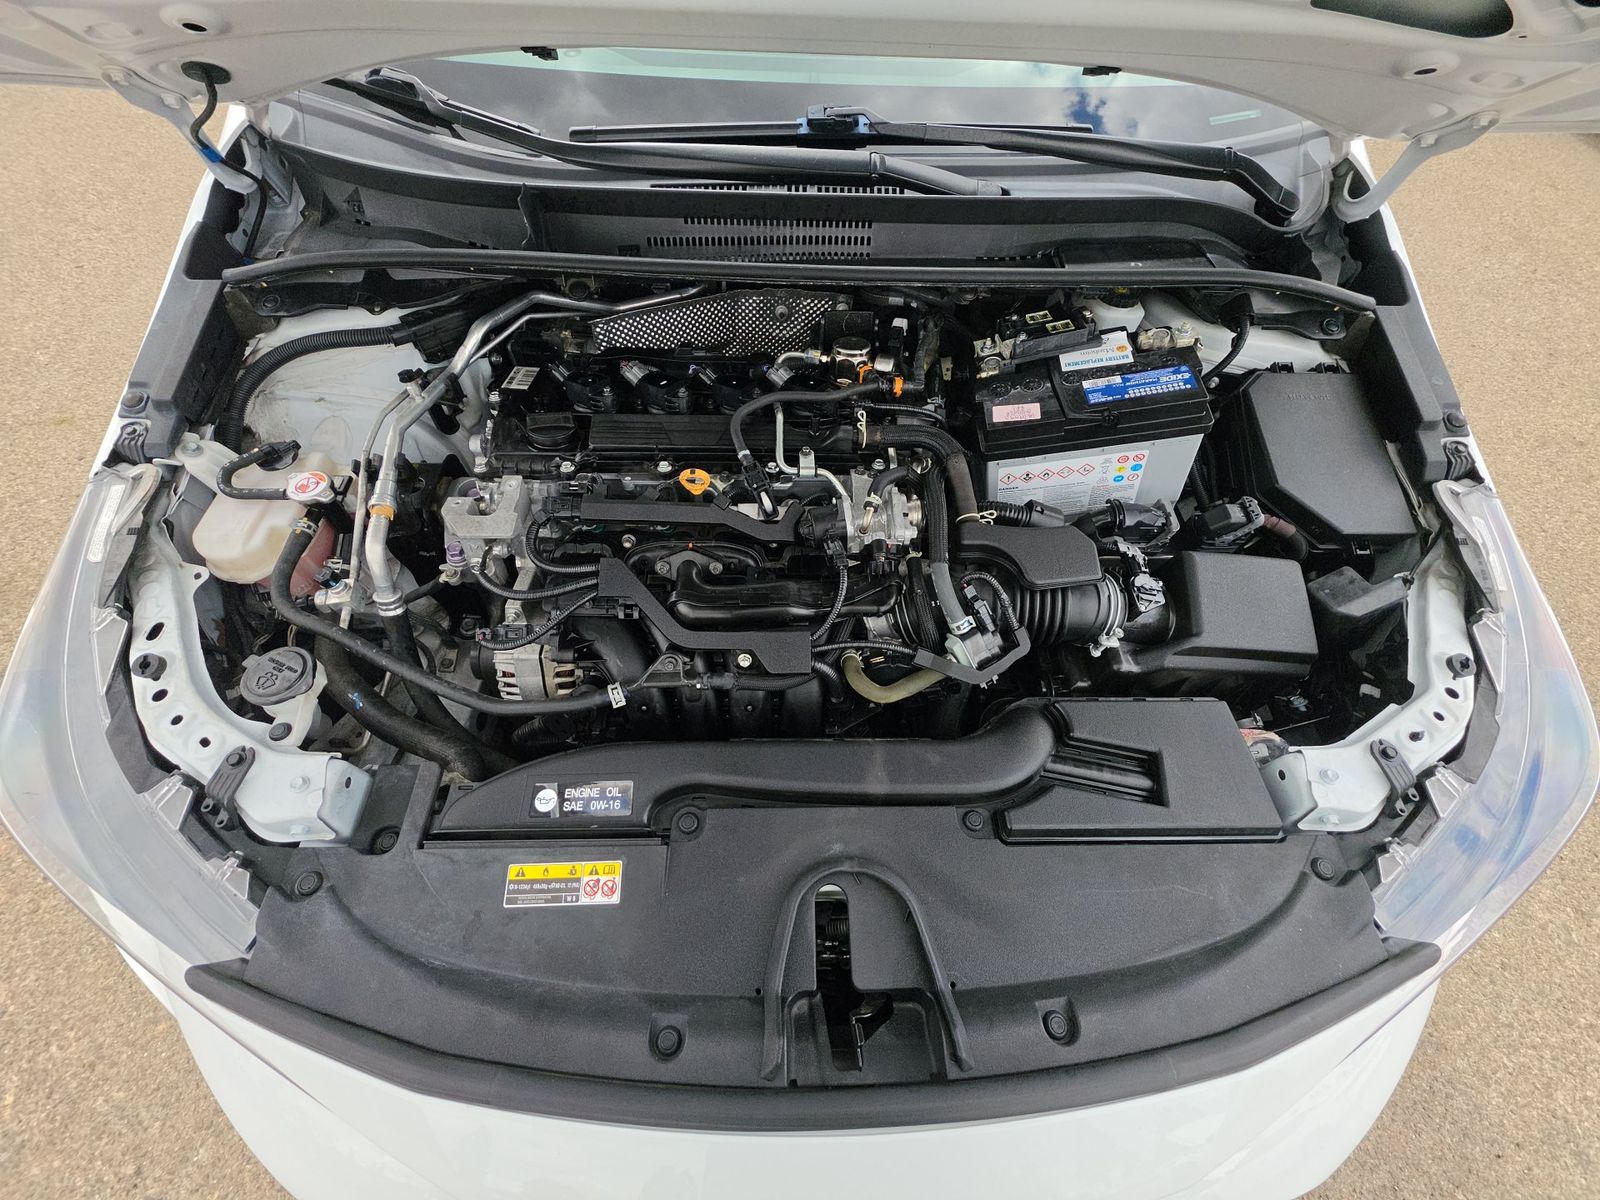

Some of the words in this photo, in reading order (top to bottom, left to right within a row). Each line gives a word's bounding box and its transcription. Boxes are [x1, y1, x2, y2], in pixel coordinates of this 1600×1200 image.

[1064, 357, 1105, 368] REPLACEMENT
[1105, 354, 1130, 363] BATTERY
[1159, 372, 1192, 382] EXIDE
[564, 787, 600, 799] ENGINE
[606, 787, 622, 797] OIL
[562, 801, 584, 811] SAE
[590, 800, 621, 810] 0W-16
